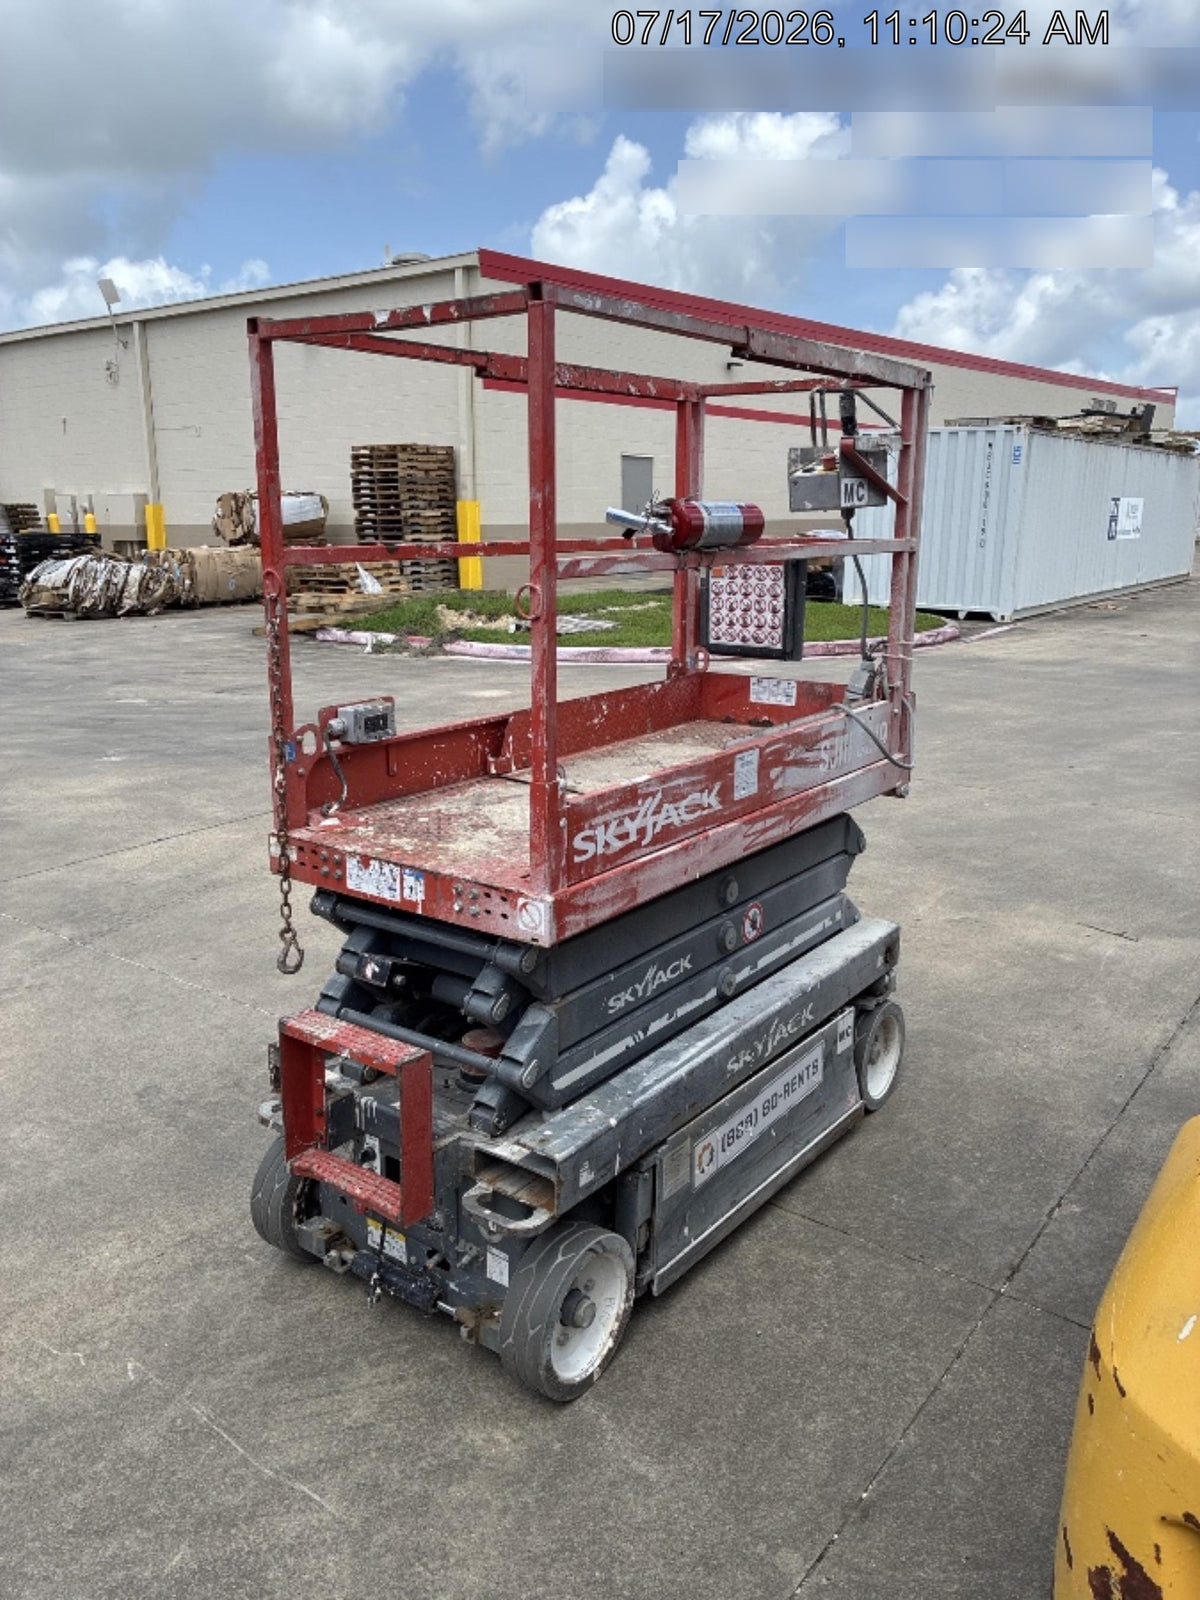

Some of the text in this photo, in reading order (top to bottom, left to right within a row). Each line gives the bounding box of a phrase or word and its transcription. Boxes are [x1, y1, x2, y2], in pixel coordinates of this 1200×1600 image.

[844, 482, 865, 504] MC
[572, 782, 722, 863] SKYJACK
[607, 953, 693, 1014] SKYJACK
[726, 1002, 814, 1077] SKYJACK
